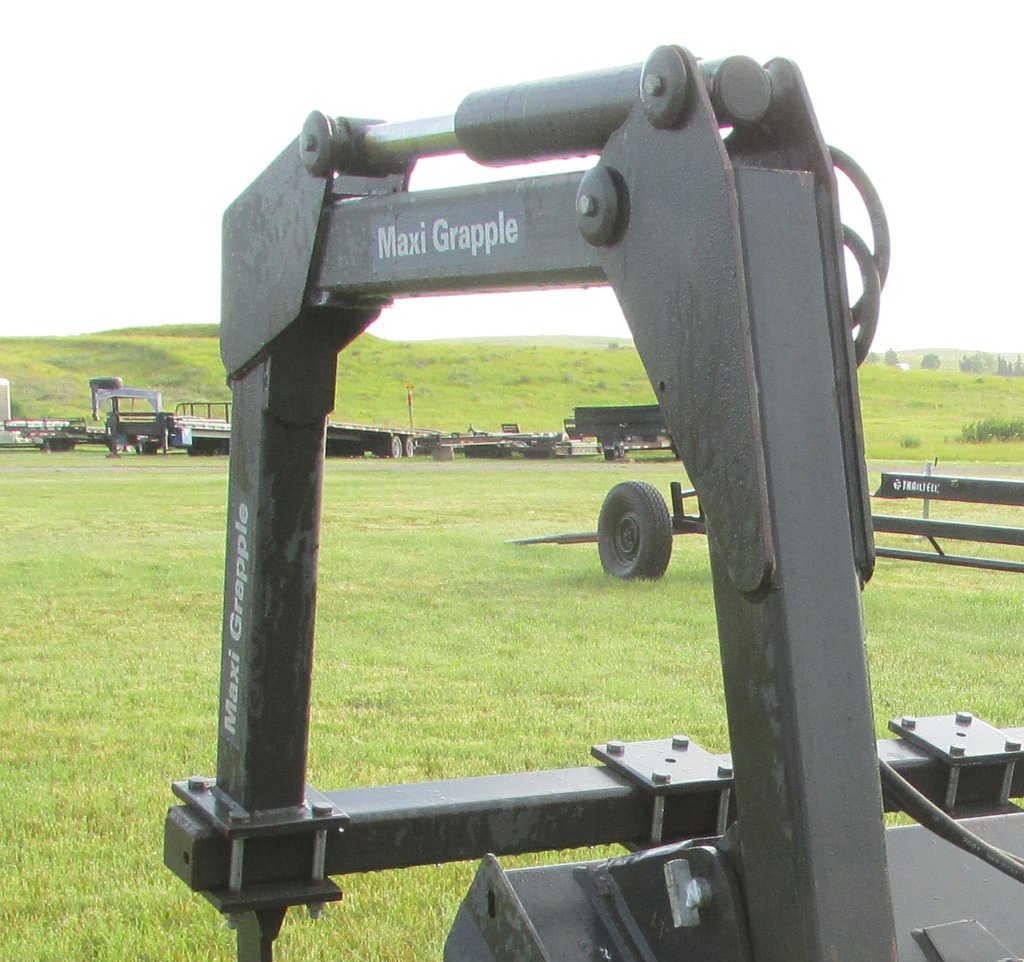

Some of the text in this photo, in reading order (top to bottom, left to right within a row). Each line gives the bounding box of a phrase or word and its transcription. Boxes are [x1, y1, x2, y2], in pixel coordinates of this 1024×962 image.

[377, 210, 519, 259] Maxi Grapple
[224, 502, 250, 736] Maxi Grapple
